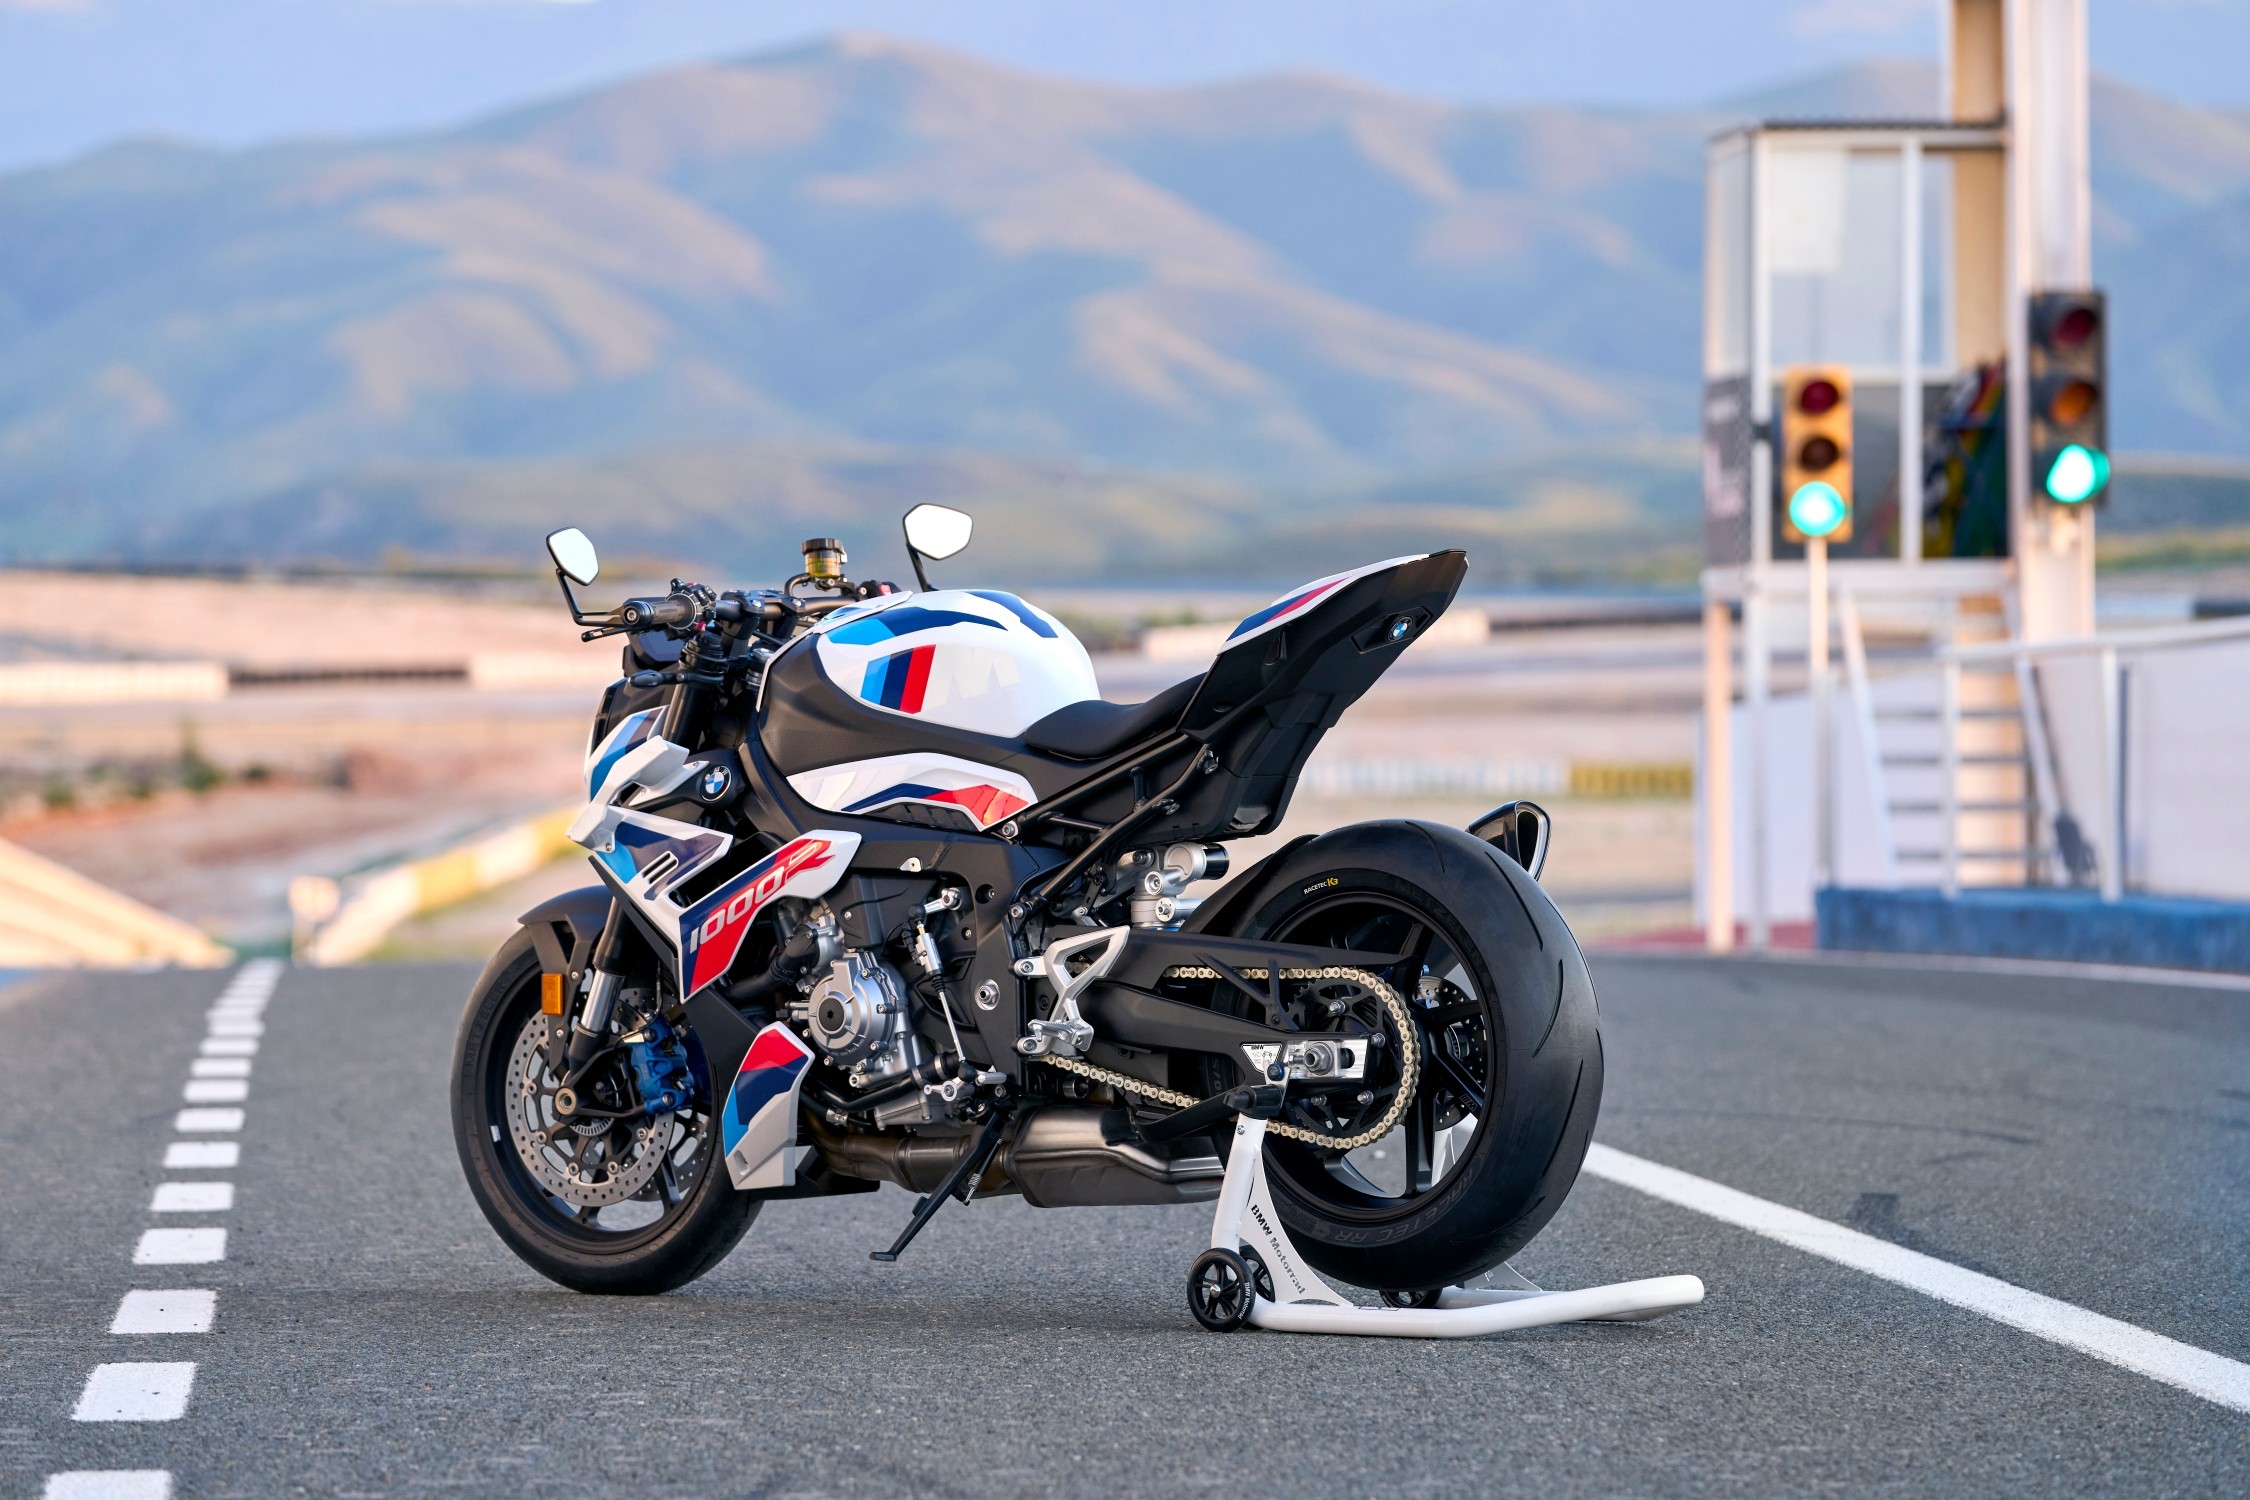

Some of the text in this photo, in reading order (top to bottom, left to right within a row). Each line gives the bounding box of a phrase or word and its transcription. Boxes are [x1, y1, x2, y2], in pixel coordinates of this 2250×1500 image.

[1303, 877, 1339, 895] RACETEC K3
[1334, 1230, 1369, 1243] RR
[1250, 1204, 1272, 1236] BMW
[1270, 1237, 1306, 1295] Motorrad
[1237, 1297, 1250, 1320] Motorrad
